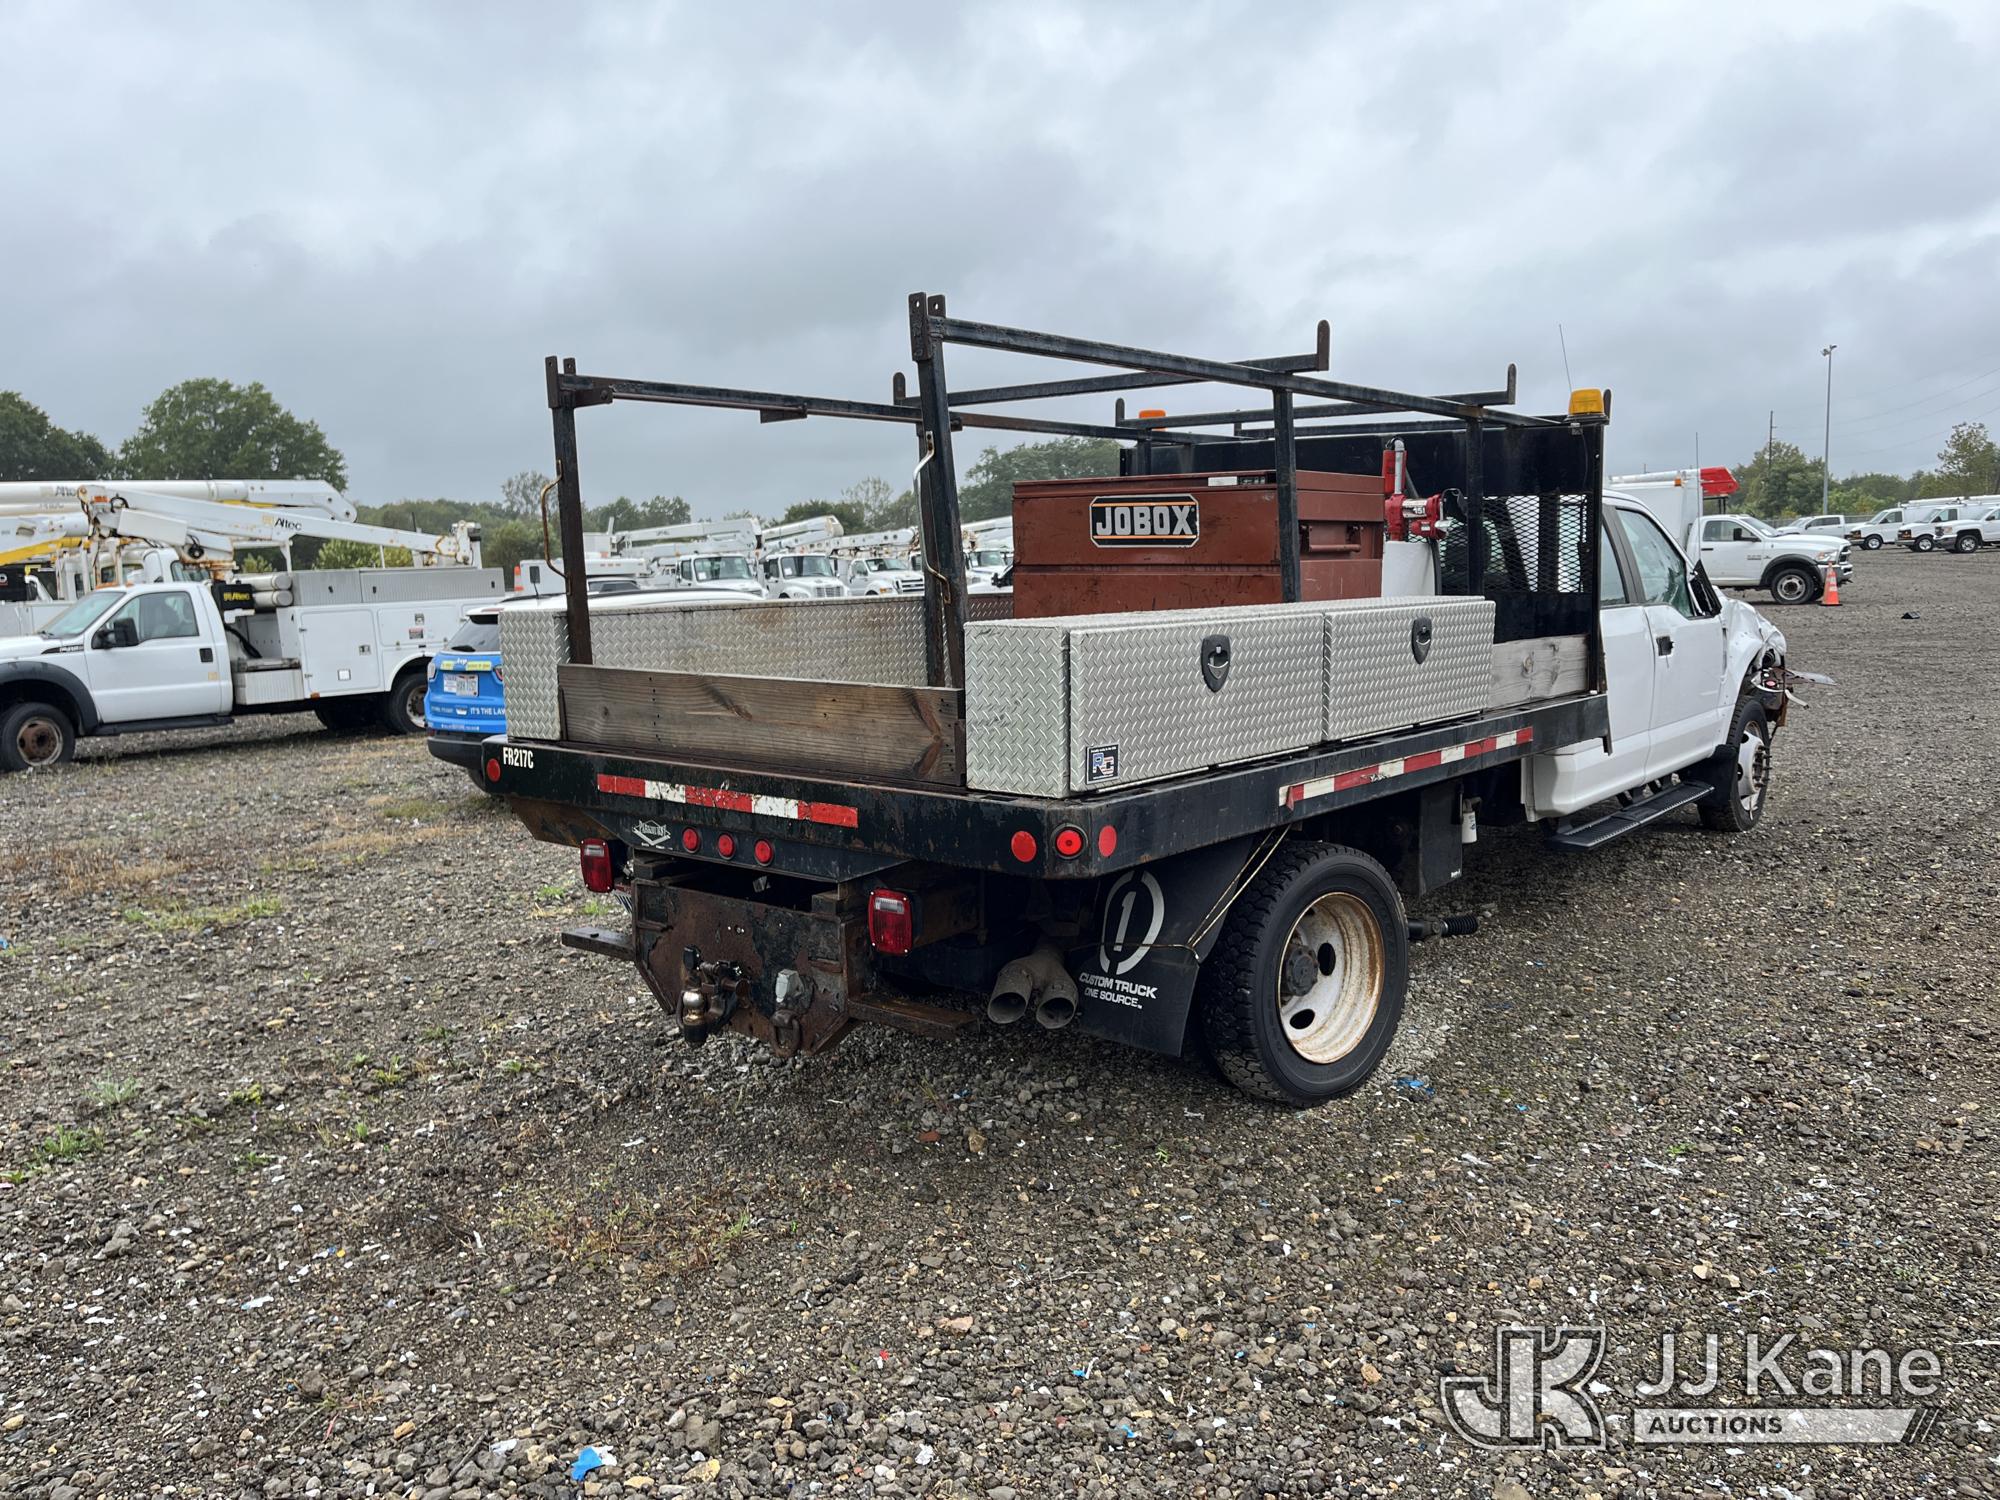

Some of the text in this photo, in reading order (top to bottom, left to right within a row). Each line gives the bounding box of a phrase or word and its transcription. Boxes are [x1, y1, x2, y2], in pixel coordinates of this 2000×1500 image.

[274, 517, 303, 531] Altec
[1095, 505, 1194, 536] JOBOX
[481, 707, 493, 716] THE
[502, 746, 535, 769] FR217C
[1079, 972, 1158, 1000] CUSTOM TRUCK
[1084, 987, 1099, 998] ONE
